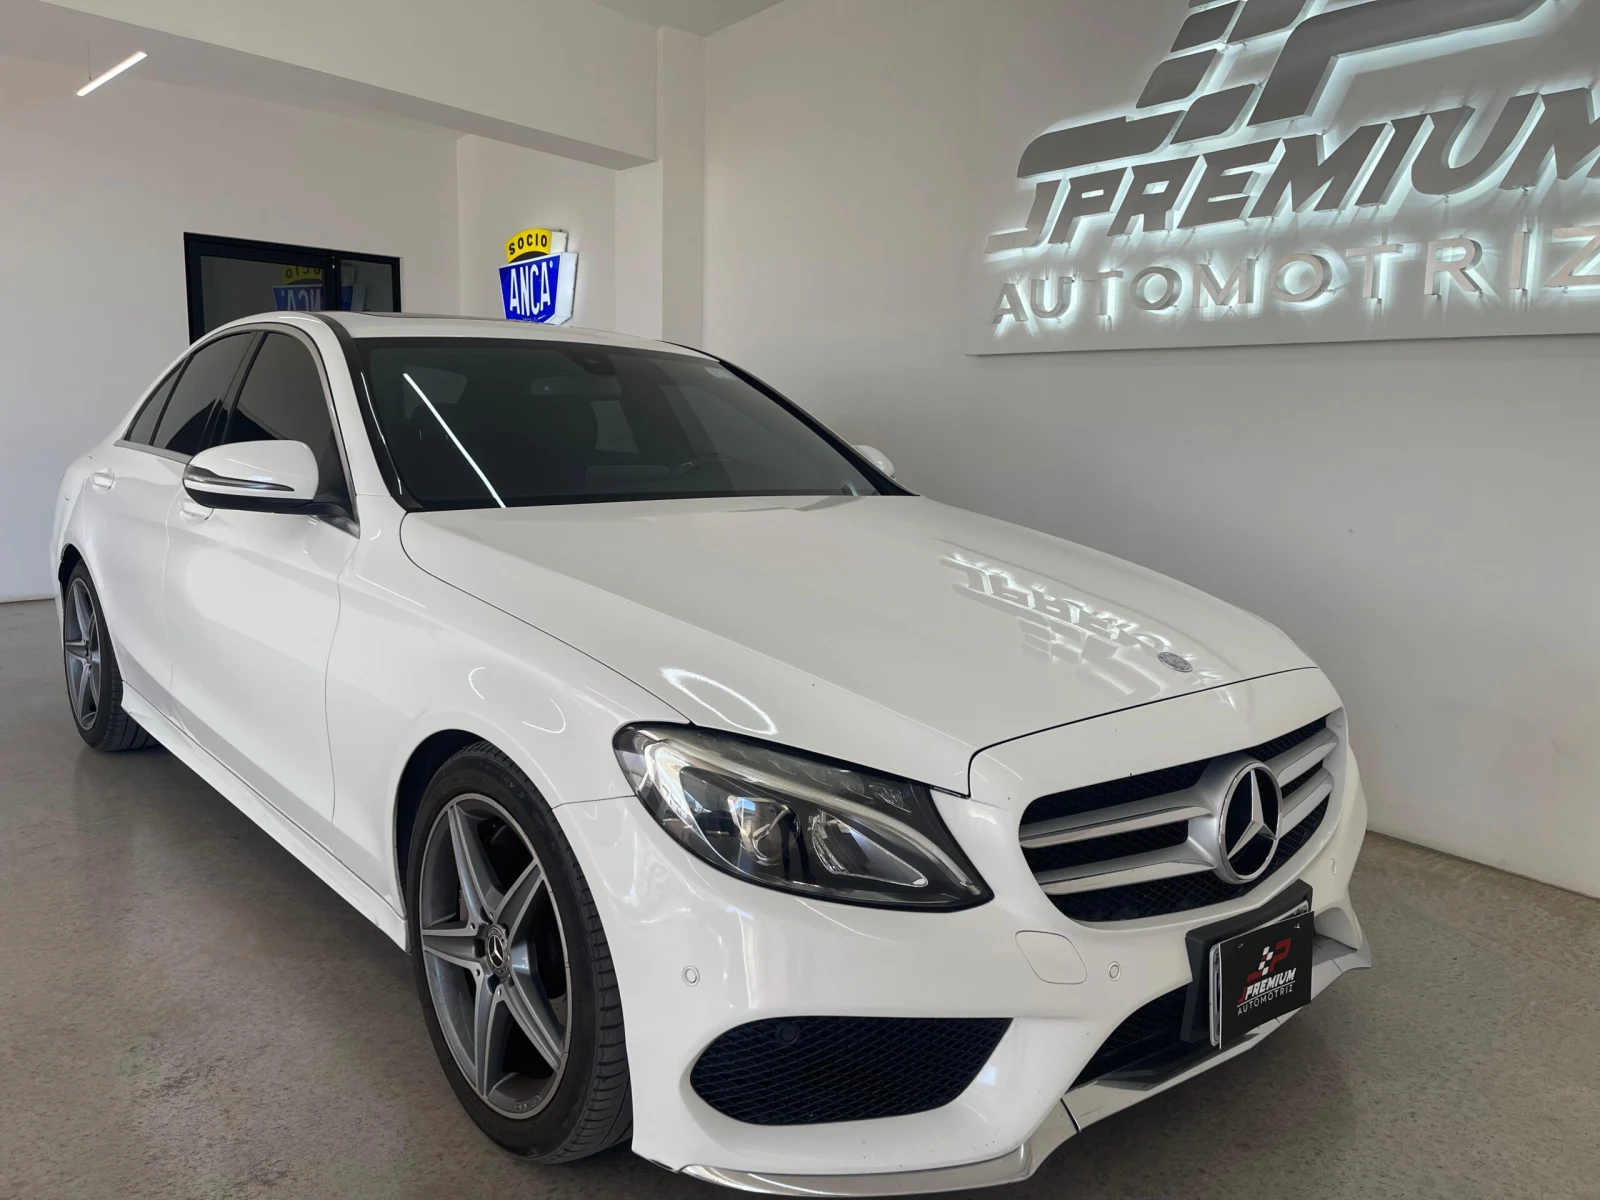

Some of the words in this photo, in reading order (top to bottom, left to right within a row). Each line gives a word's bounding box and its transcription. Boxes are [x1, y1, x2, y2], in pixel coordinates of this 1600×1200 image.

[508, 233, 548, 255] SOCIO
[509, 261, 551, 317] ANCA
[991, 224, 1600, 324] AUTOMOTRIZ
[1237, 984, 1293, 1016] AUTOMOTRIZ
